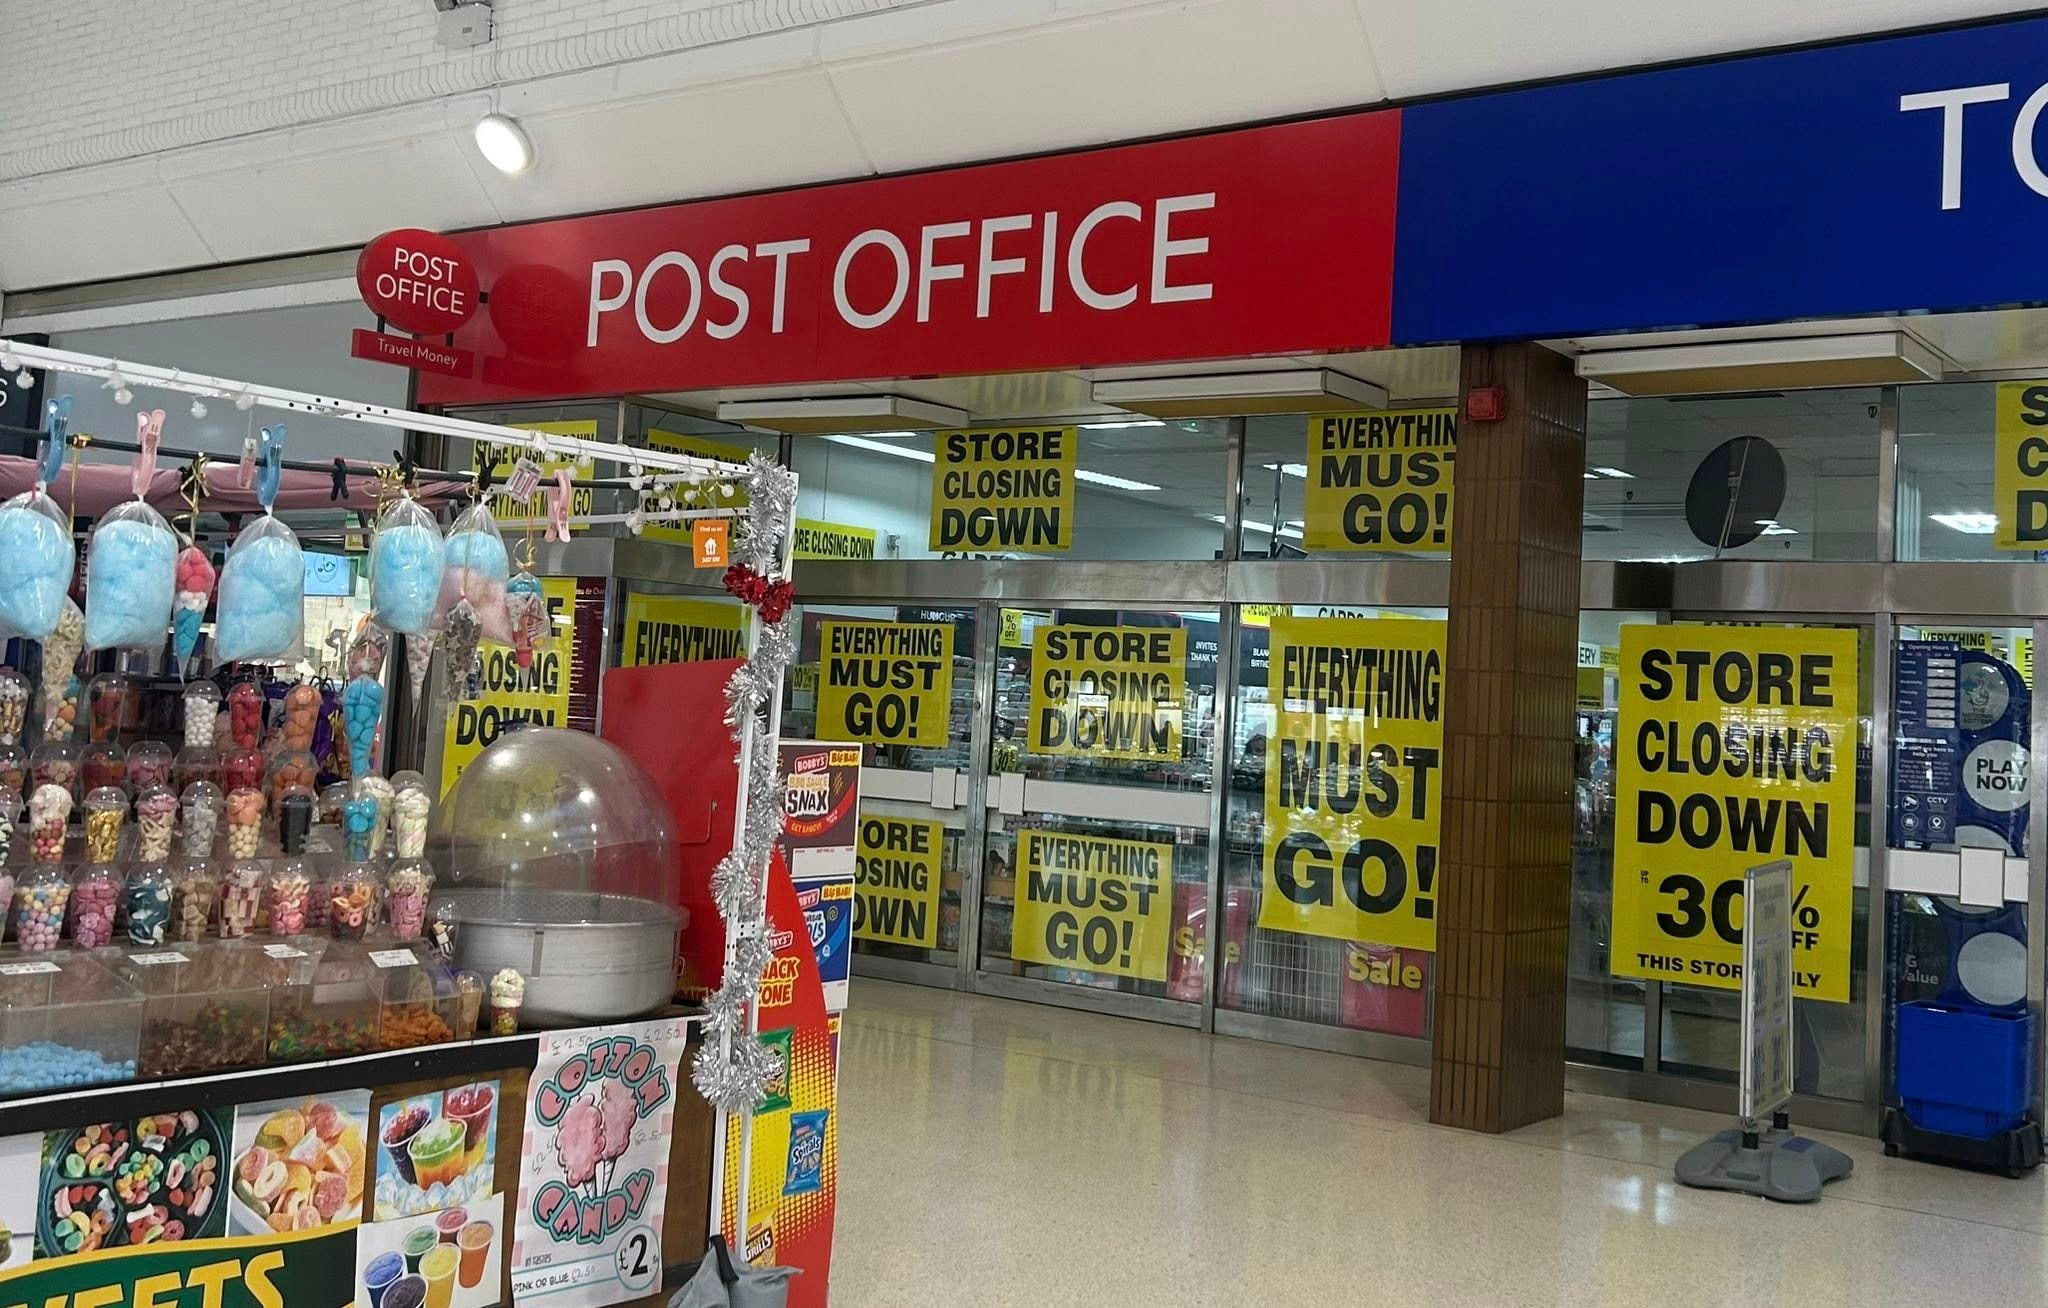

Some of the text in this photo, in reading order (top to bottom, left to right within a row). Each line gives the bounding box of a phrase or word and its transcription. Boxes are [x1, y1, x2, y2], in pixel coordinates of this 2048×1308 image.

[395, 248, 458, 284] POST
[587, 192, 1216, 348] POST OFFICE
[375, 273, 465, 316] OFFICE
[378, 338, 458, 369] Travel Money
[946, 431, 1063, 463] STORE
[1322, 413, 1457, 450] EVERYTHIN
[943, 467, 1061, 500] CLOSING
[573, 489, 591, 516] GO
[1343, 492, 1448, 544] GO!
[794, 528, 875, 560] ORE CLOSING DOWN
[940, 506, 1060, 547] DOWN
[832, 626, 942, 657] EVERYTHING
[1046, 630, 1171, 664] STORE
[1253, 647, 1269, 657] BLAN
[1908, 644, 1931, 652] Opening
[829, 658, 942, 690] MUST
[1043, 669, 1171, 704] CLOSING
[1283, 645, 1441, 723] EVERYTHING
[1639, 648, 1834, 708] STORE
[844, 694, 920, 739] GO!
[1040, 707, 1169, 755] DOWN
[797, 757, 825, 772] BOBBY'S
[1637, 718, 1832, 784] CLOSING
[1976, 758, 2028, 775] PLAY
[1278, 738, 1439, 821] MUST
[1976, 775, 2027, 792] NOW
[787, 790, 827, 814] SNAX
[1927, 796, 1948, 805] CCTV
[858, 819, 930, 853] ORE
[1637, 790, 1829, 859] DOWN
[854, 857, 929, 893] OSING
[1028, 835, 1159, 880] EVERYTHING
[1273, 831, 1437, 920] GO!
[1028, 871, 1159, 916] MUST
[852, 892, 927, 940] OWN
[1045, 911, 1134, 969] GO!
[1176, 925, 1241, 965] Sae
[1792, 933, 1820, 951] FF
[762, 959, 797, 979] ACK
[1348, 949, 1423, 990] Sale
[1637, 954, 1821, 990] THIS STOR LY
[761, 984, 792, 1004] ONE
[536, 1036, 670, 1126] COTTON
[793, 1136, 821, 1164] Spirals
[533, 1169, 654, 1244] CANDY
[513, 1273, 569, 1293] PINK OR BLUE
